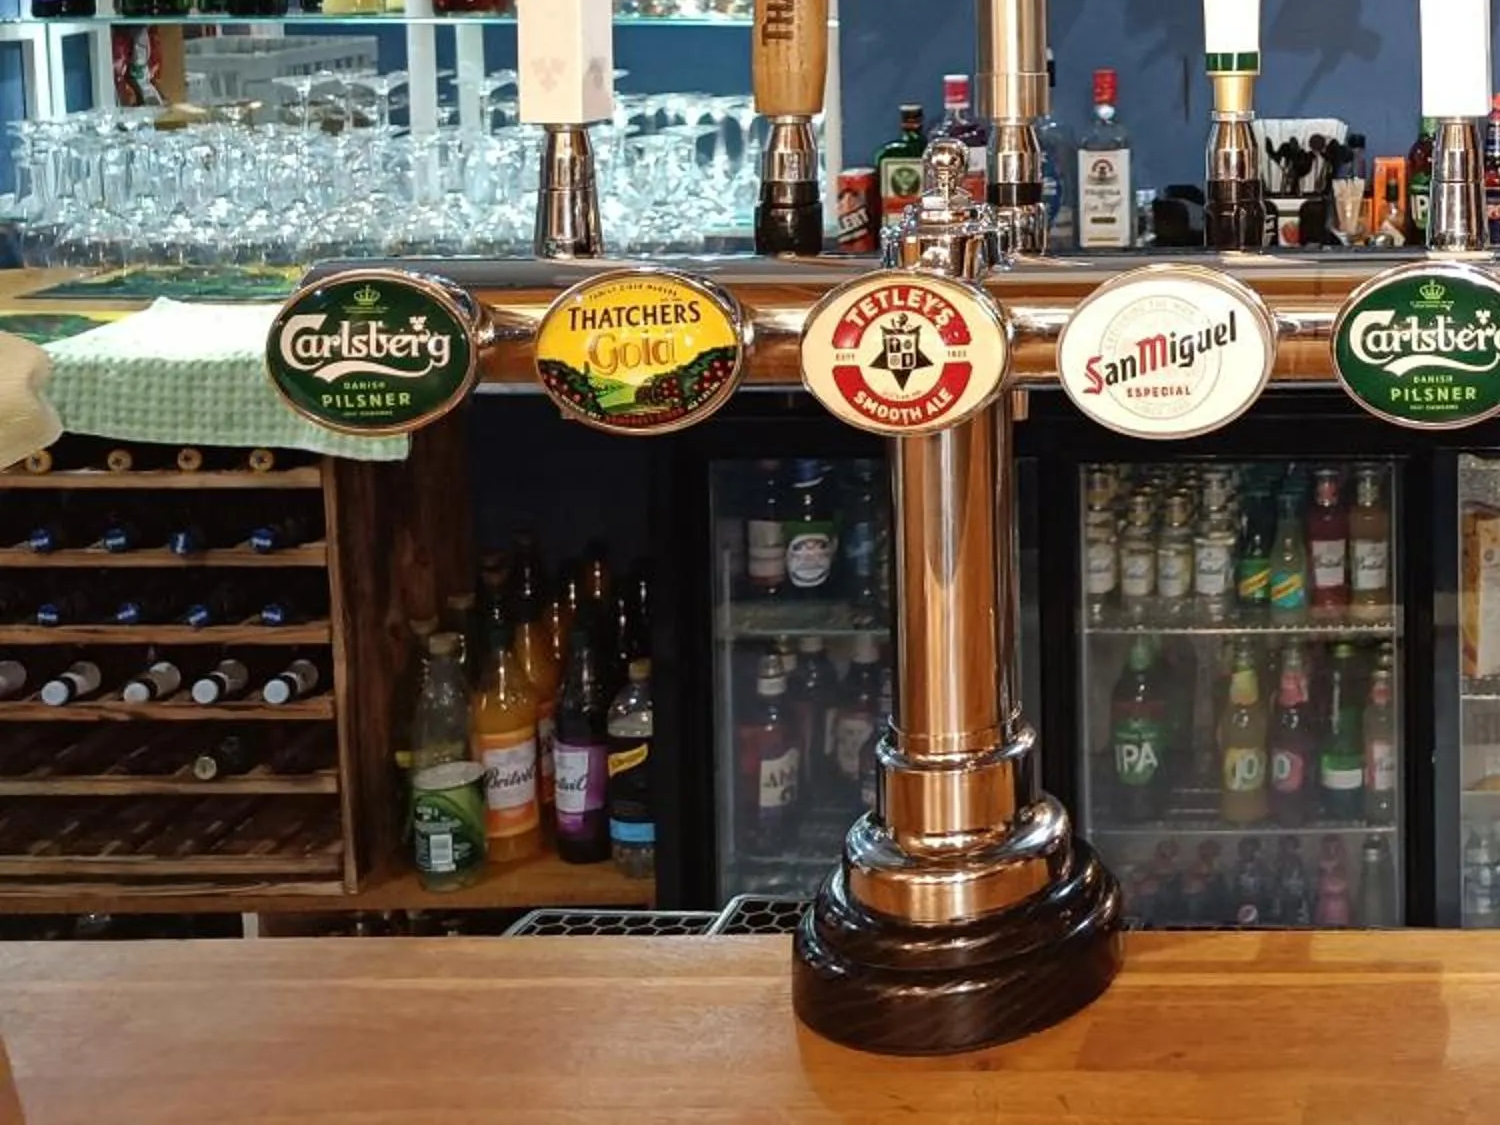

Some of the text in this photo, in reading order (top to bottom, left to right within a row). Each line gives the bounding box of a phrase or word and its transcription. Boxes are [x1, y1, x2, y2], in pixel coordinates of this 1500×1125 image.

[568, 300, 702, 333] THATCHERS
[846, 288, 955, 329] TETLEY'S
[279, 313, 452, 378] Carlsberg
[587, 328, 677, 376] Gold
[321, 392, 412, 409] PILSNER
[853, 387, 955, 425] SMOOTH ALE
[1126, 386, 1192, 398] ESPECIAL
[1391, 386, 1478, 402] PILSNER
[1114, 741, 1159, 774] IPA
